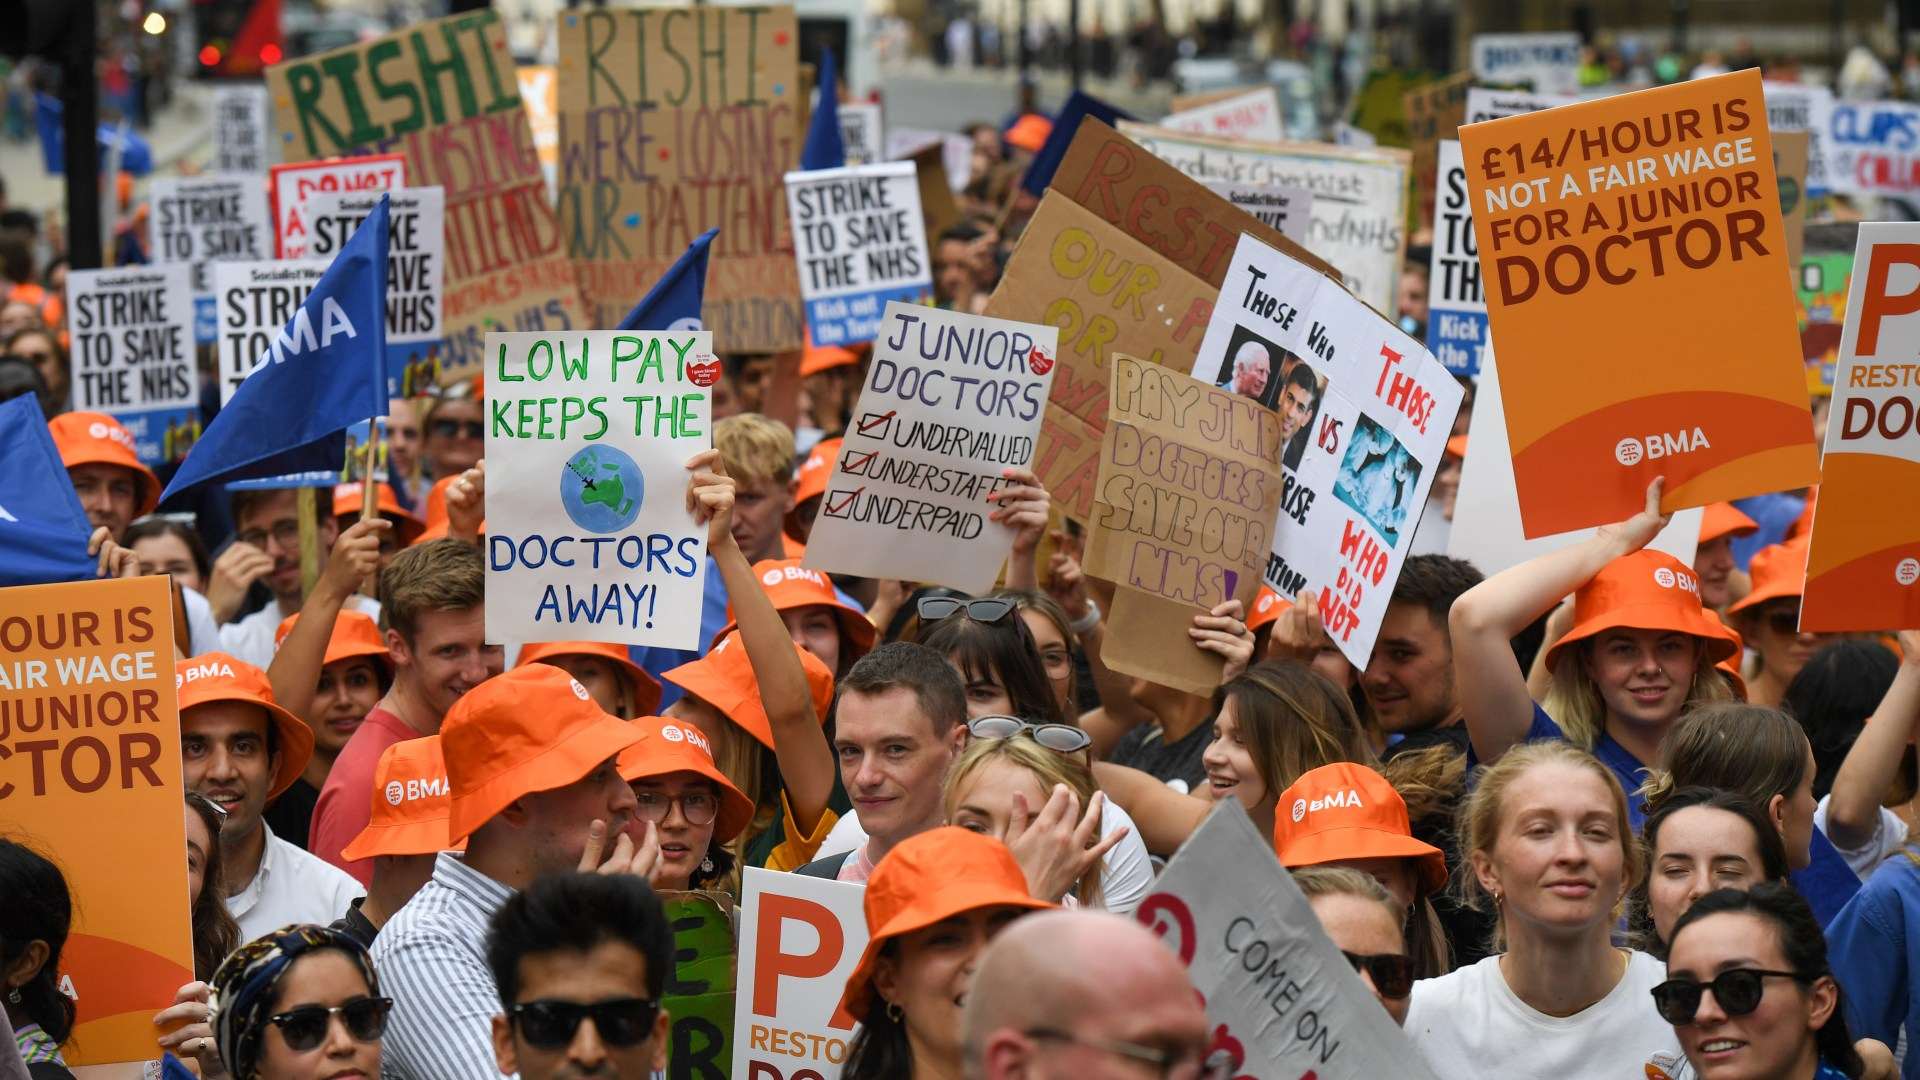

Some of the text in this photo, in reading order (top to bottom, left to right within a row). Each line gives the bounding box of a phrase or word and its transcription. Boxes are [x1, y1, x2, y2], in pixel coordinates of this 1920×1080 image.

[585, 8, 770, 107] RISHI
[286, 9, 520, 155] RISHI
[558, 104, 660, 184] WERE
[673, 103, 793, 184] LOSING
[1481, 108, 1703, 180] £14/HOUR
[1712, 99, 1751, 135] IS
[796, 177, 892, 220] STRIKE
[1484, 137, 1757, 214] NOT A FAIR WAGE
[159, 193, 243, 226] STRIKE
[558, 175, 632, 260] OUR
[800, 210, 912, 255] TO SAVE
[1073, 139, 1241, 281] REST
[1490, 170, 1763, 251] FOR A JUNIOR
[162, 231, 193, 259] TO
[807, 255, 858, 291] THE
[868, 246, 921, 281] NHS
[1496, 209, 1771, 307] DOCTOR
[1050, 226, 1161, 321] OUR
[1440, 260, 1487, 303] TH
[76, 289, 168, 329] STRIKE
[226, 286, 312, 328] STRI
[1242, 264, 1298, 332] THOSE
[78, 326, 184, 367] TO SAVE
[887, 313, 1034, 375] JUNIOR
[1043, 297, 1119, 368] OR
[1306, 320, 1336, 363] WHO
[1439, 314, 1480, 340] Kick
[498, 335, 697, 384] LOW PAY
[1438, 343, 1469, 369] the
[1849, 364, 1920, 389] REST
[80, 370, 130, 406] THE
[141, 364, 190, 400] NHS
[871, 359, 1044, 422] DOCTORS
[1375, 340, 1437, 437] THOSE
[491, 393, 707, 441] KEEPS THE
[1116, 358, 1200, 429] PAY
[1200, 391, 1281, 465] JNR
[1317, 412, 1344, 456] VS
[1841, 395, 1920, 441] DO
[893, 418, 1033, 466] UNDERVALUED
[1645, 426, 1711, 459] BMA
[1112, 423, 1265, 513] DOCTORS
[852, 491, 983, 540] UNDERPAID
[1099, 474, 1267, 571] SAVE OUR
[1280, 471, 1317, 527] RISE
[489, 533, 700, 579] DOCTORS
[783, 566, 825, 588] BMA
[1339, 518, 1389, 588] WHO
[535, 582, 657, 630] AWAY!
[1336, 566, 1363, 611] DID
[0, 606, 154, 653] OUR IS
[1317, 584, 1361, 644] NOT
[0, 650, 158, 690] AIR WAGE
[186, 661, 236, 683] BMA
[0, 688, 161, 742] JUNIOR
[1309, 789, 1363, 813] BMA
[1224, 916, 1341, 1065] COME ON
[750, 1024, 849, 1065] RESTO
